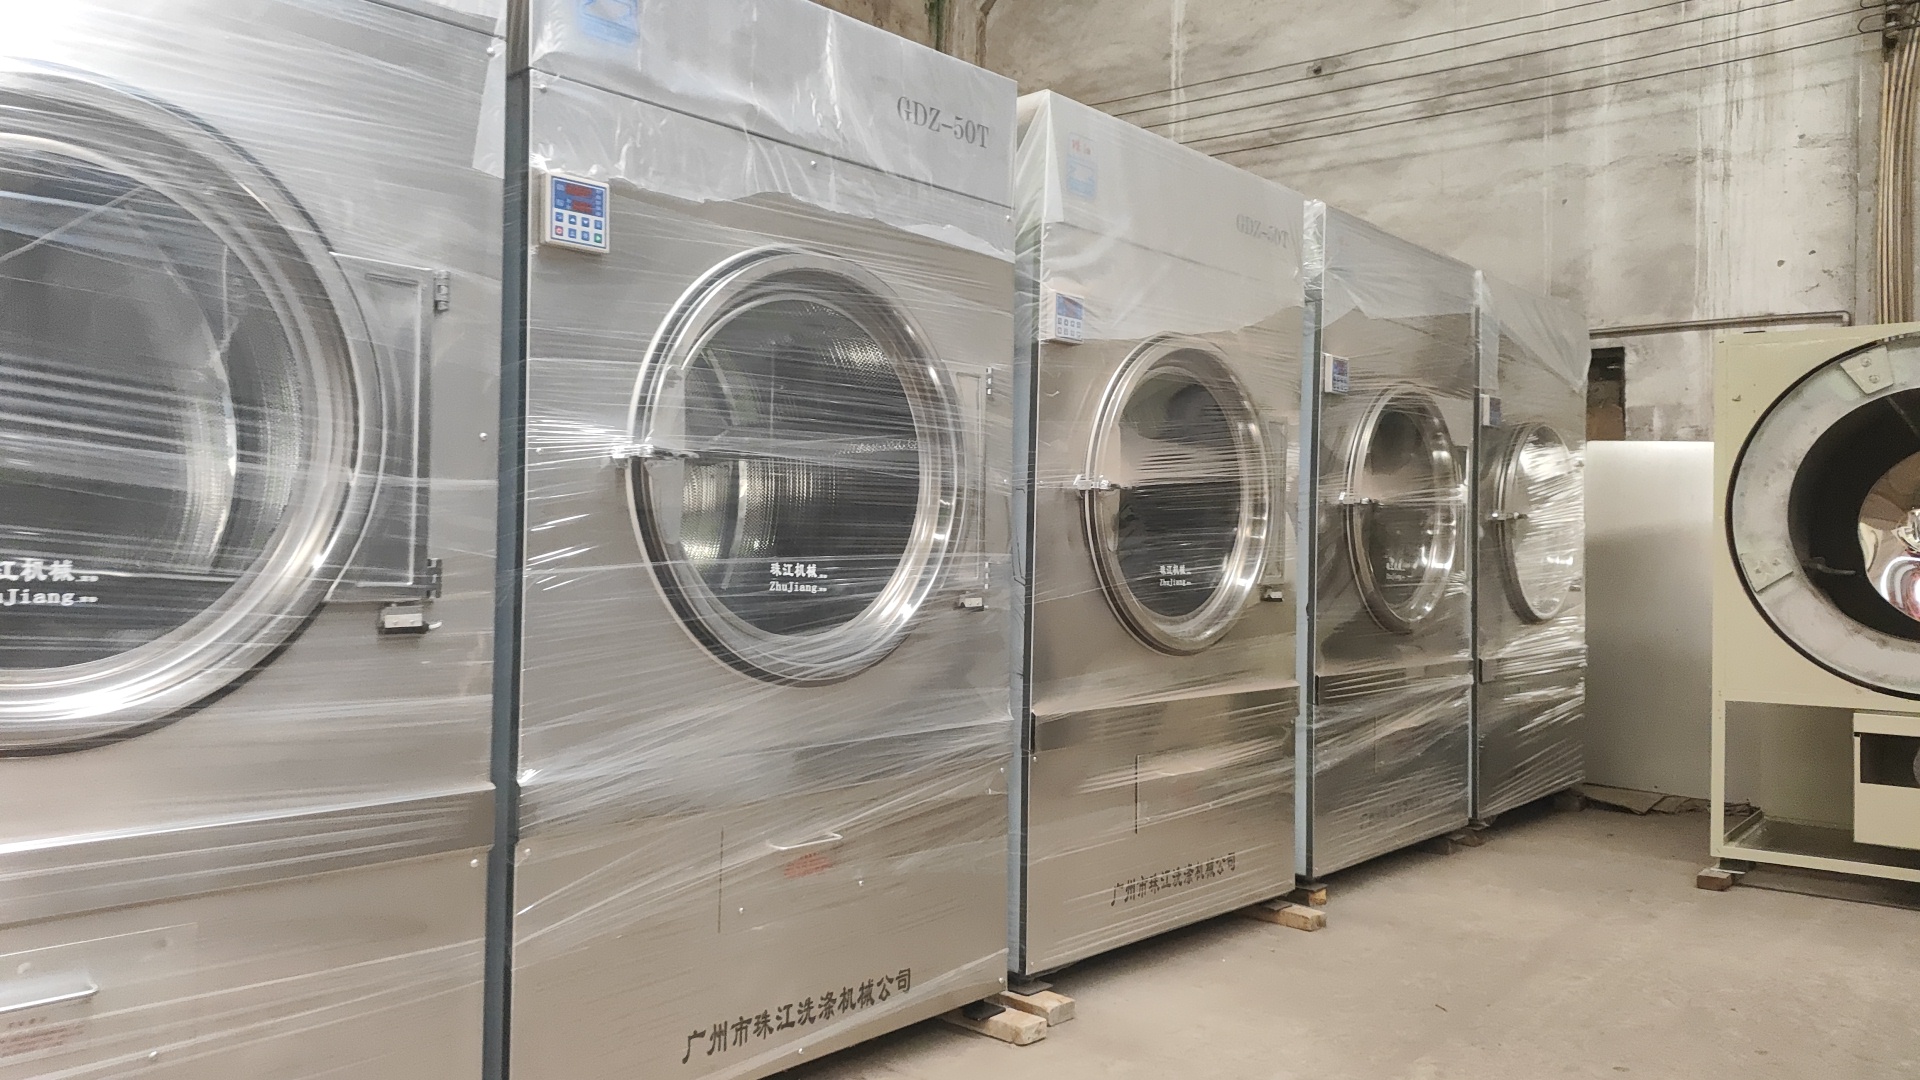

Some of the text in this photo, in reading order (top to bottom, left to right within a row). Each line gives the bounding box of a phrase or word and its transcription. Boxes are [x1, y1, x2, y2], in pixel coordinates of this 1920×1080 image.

[897, 96, 989, 149] GDZ-50T
[769, 581, 817, 593] ZhuJiang
[770, 562, 818, 578] 珠江机械
[682, 968, 911, 1064] 广州市珠江洗涤机械公司
